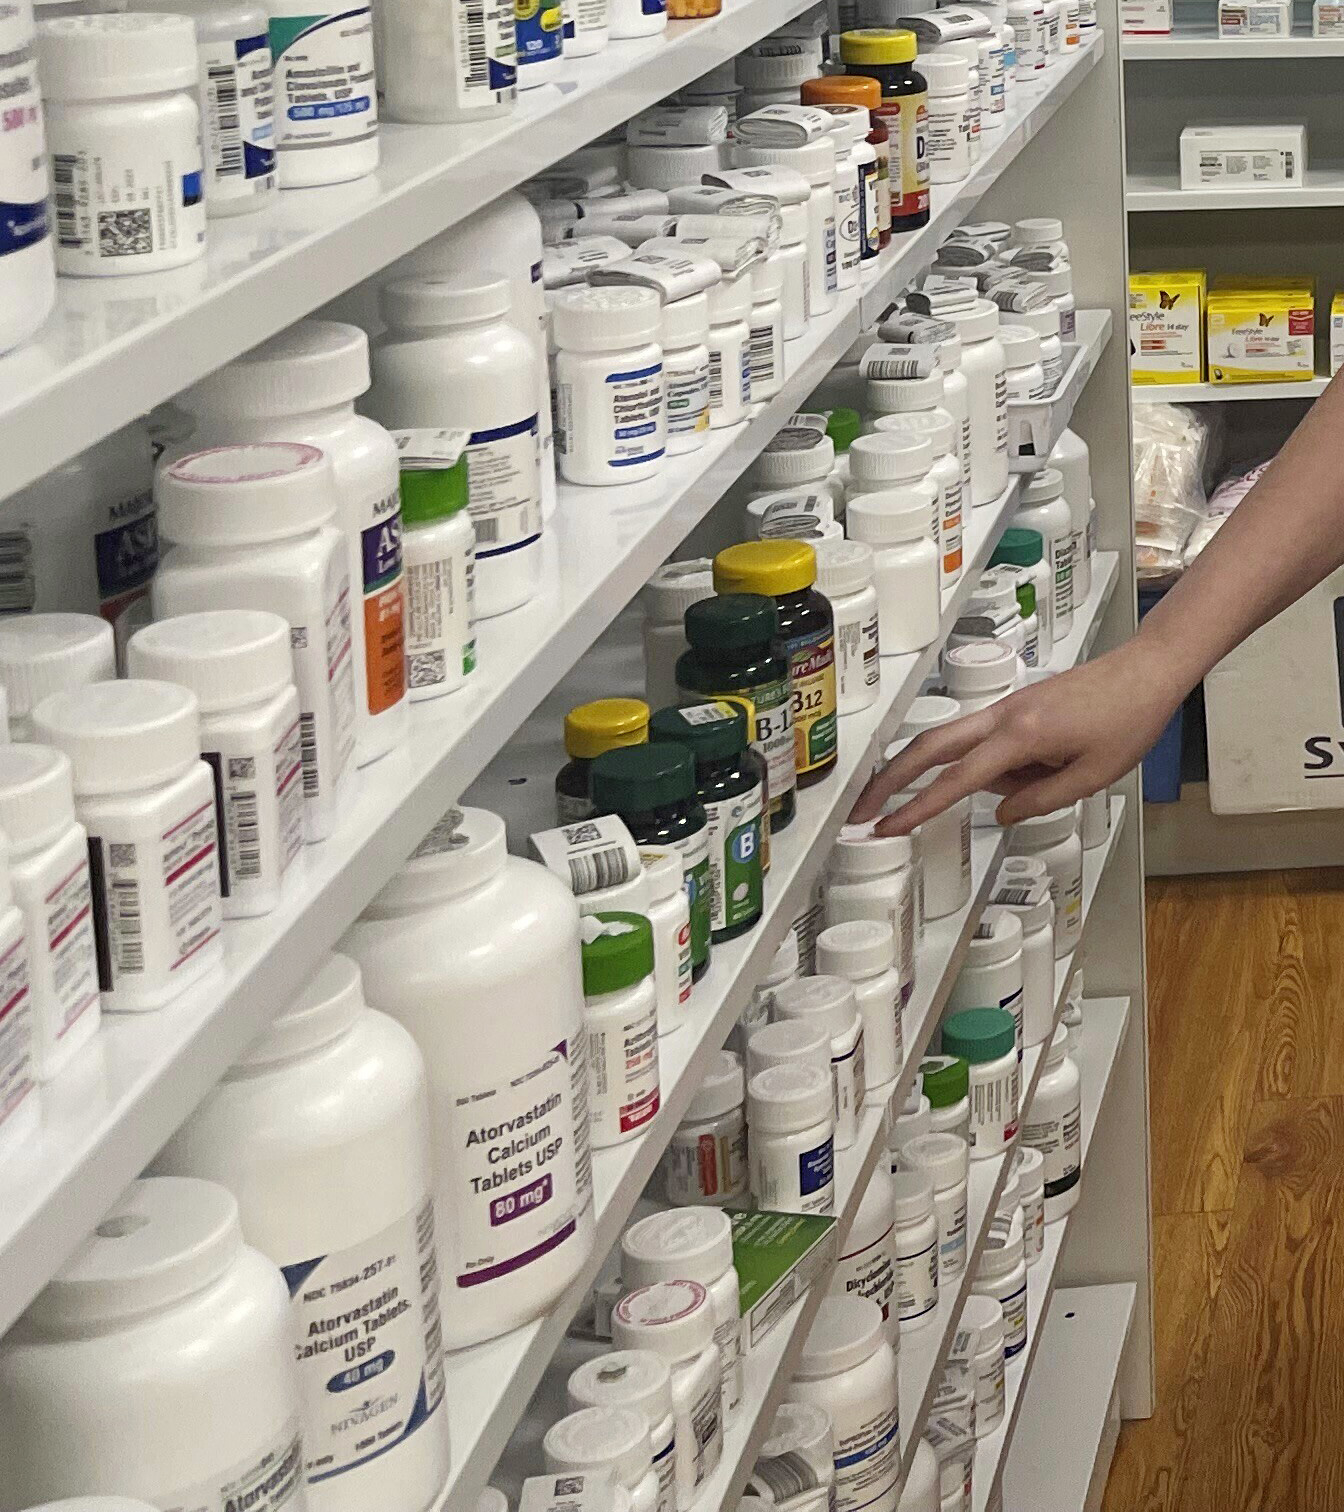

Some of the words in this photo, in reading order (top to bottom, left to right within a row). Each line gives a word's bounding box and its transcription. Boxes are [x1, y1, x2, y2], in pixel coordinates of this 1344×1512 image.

[1129, 311, 1164, 322] eeStyle
[466, 1093, 562, 1147] Atorvastatin
[488, 1125, 551, 1164] Calcium
[471, 1160, 532, 1194] Tablets
[537, 1138, 563, 1165] USP
[495, 1198, 515, 1218] 80
[308, 1287, 399, 1338] Atorvastatin
[344, 1336, 377, 1363] USP
